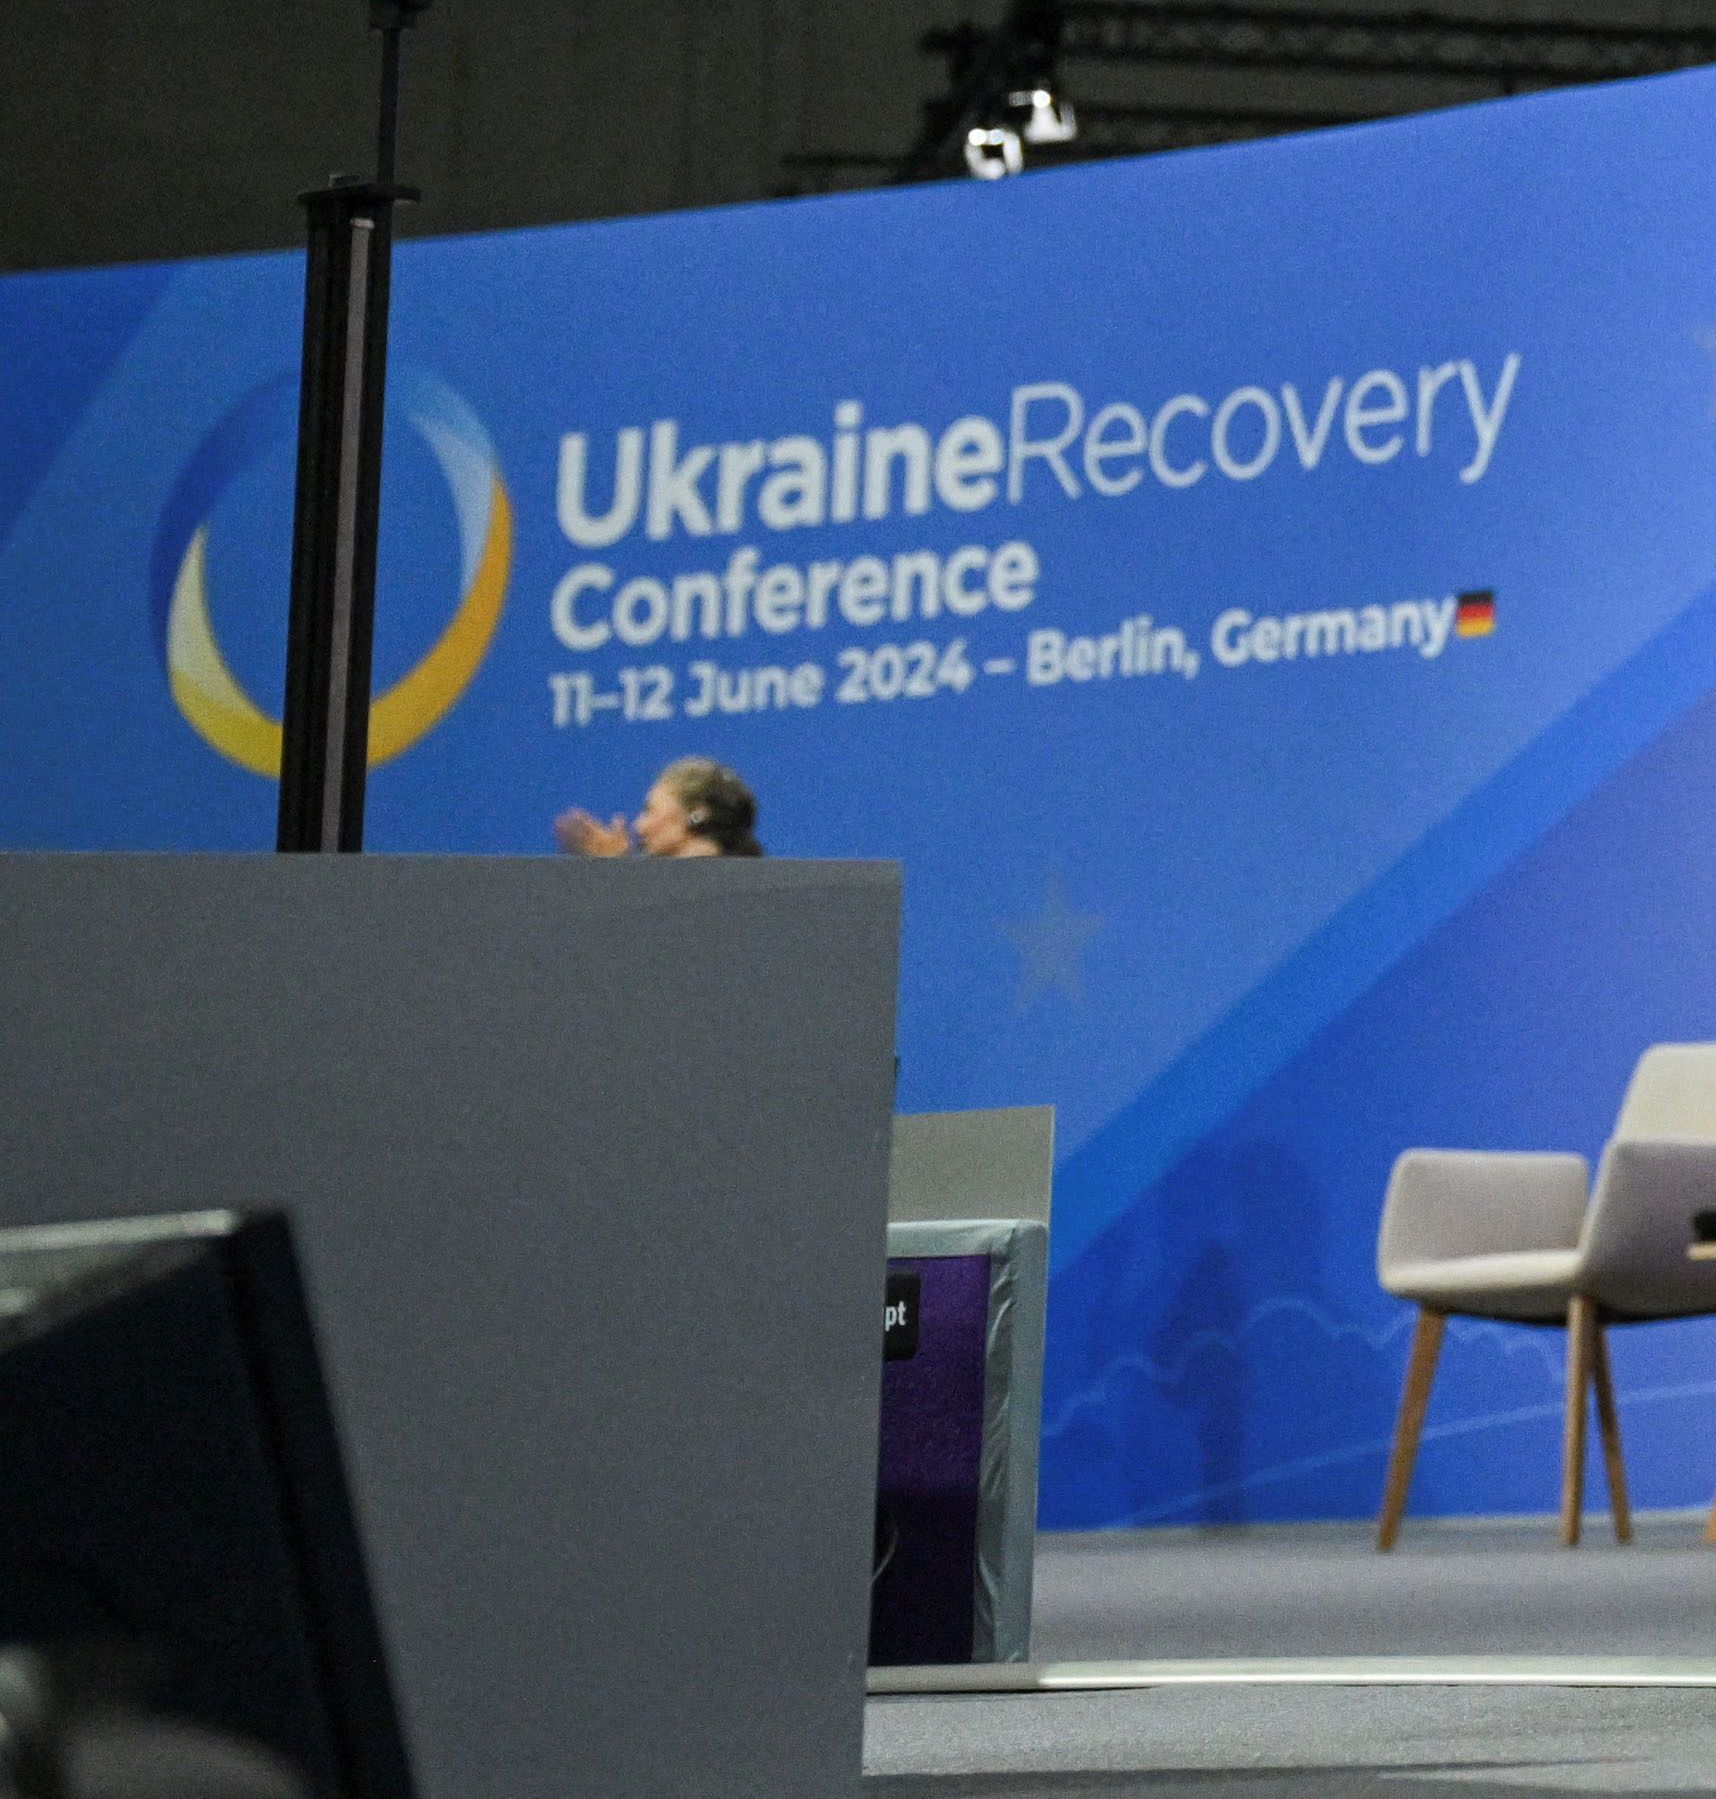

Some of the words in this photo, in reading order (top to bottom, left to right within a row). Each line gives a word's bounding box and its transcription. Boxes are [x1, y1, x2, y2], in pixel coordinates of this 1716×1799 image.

[548, 540, 1040, 651] Conference
[684, 659, 826, 718] June
[834, 637, 977, 704] 2024
[1025, 614, 1201, 687] Berlin,
[1210, 593, 1458, 667] Germany
